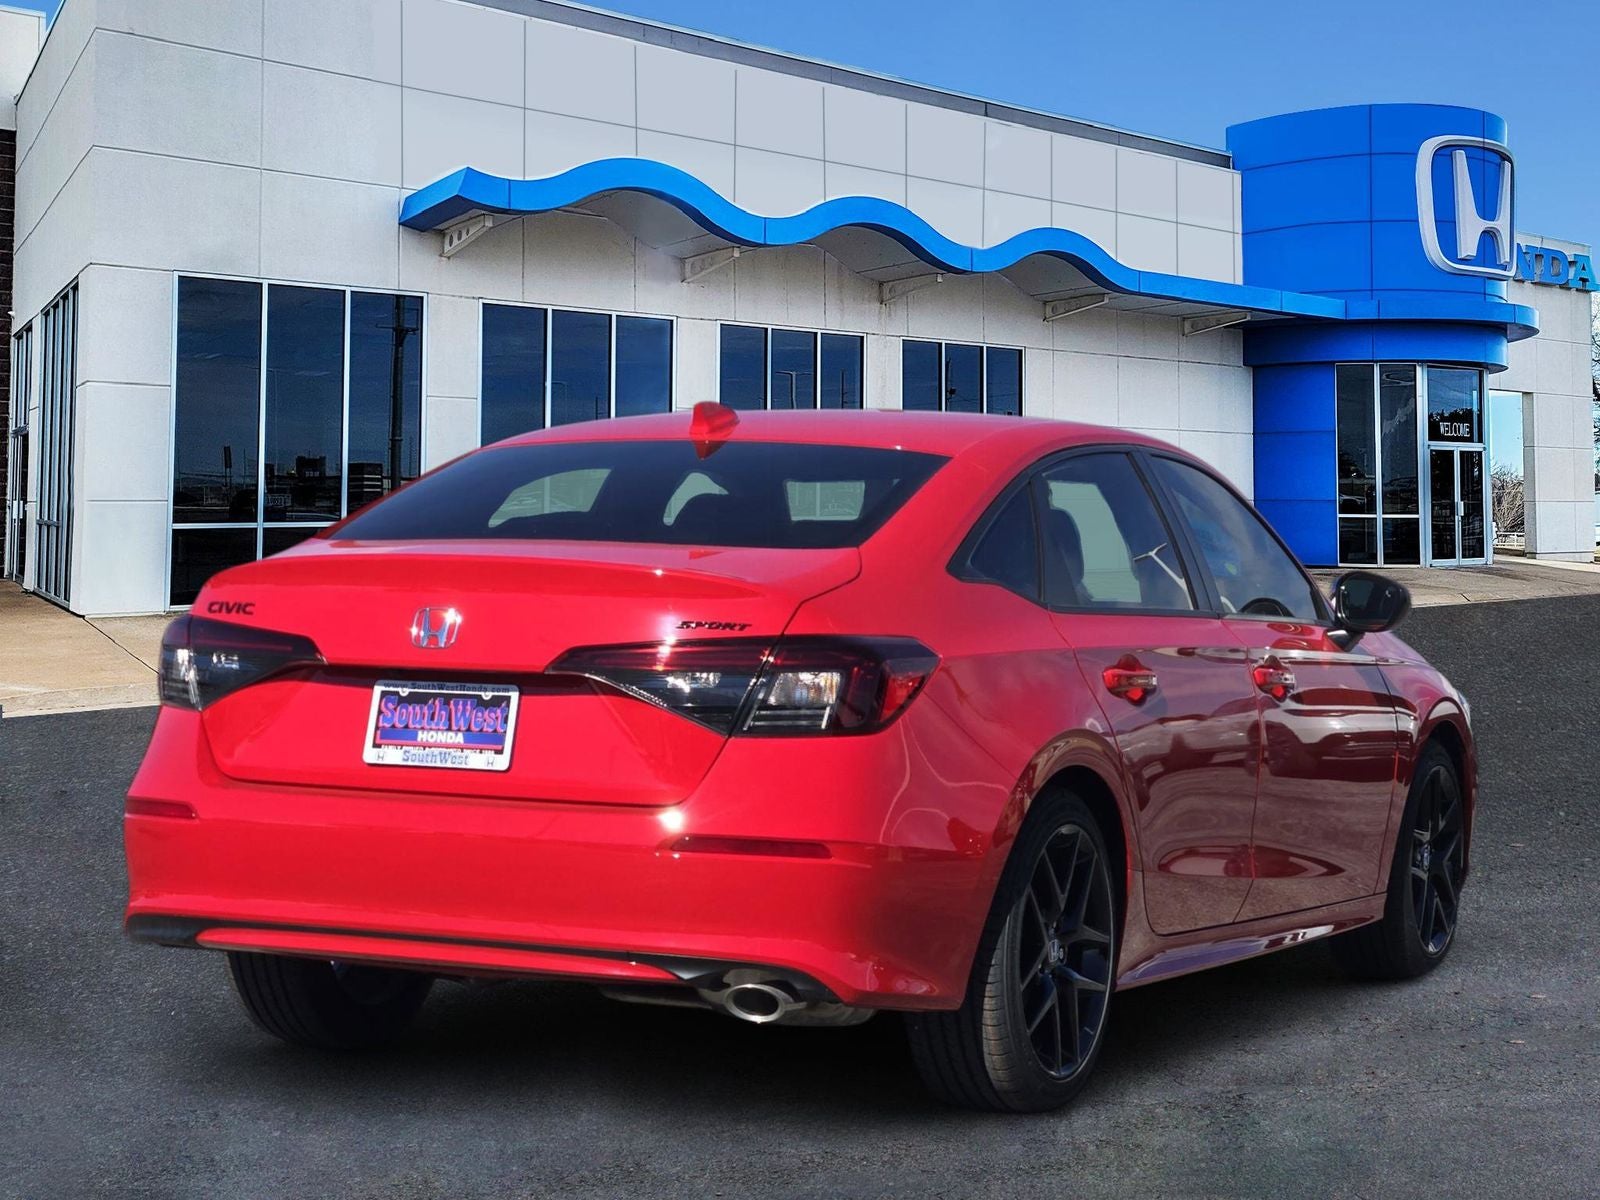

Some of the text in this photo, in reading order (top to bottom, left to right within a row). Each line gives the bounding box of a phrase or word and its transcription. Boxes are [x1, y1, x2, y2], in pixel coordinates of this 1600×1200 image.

[1439, 421, 1471, 437] WELCOME
[208, 601, 256, 616] CIVIC
[676, 620, 752, 631] SPORT
[378, 694, 509, 733] SouthWest
[416, 730, 465, 744] HONDA
[402, 750, 470, 766] SouthWest
